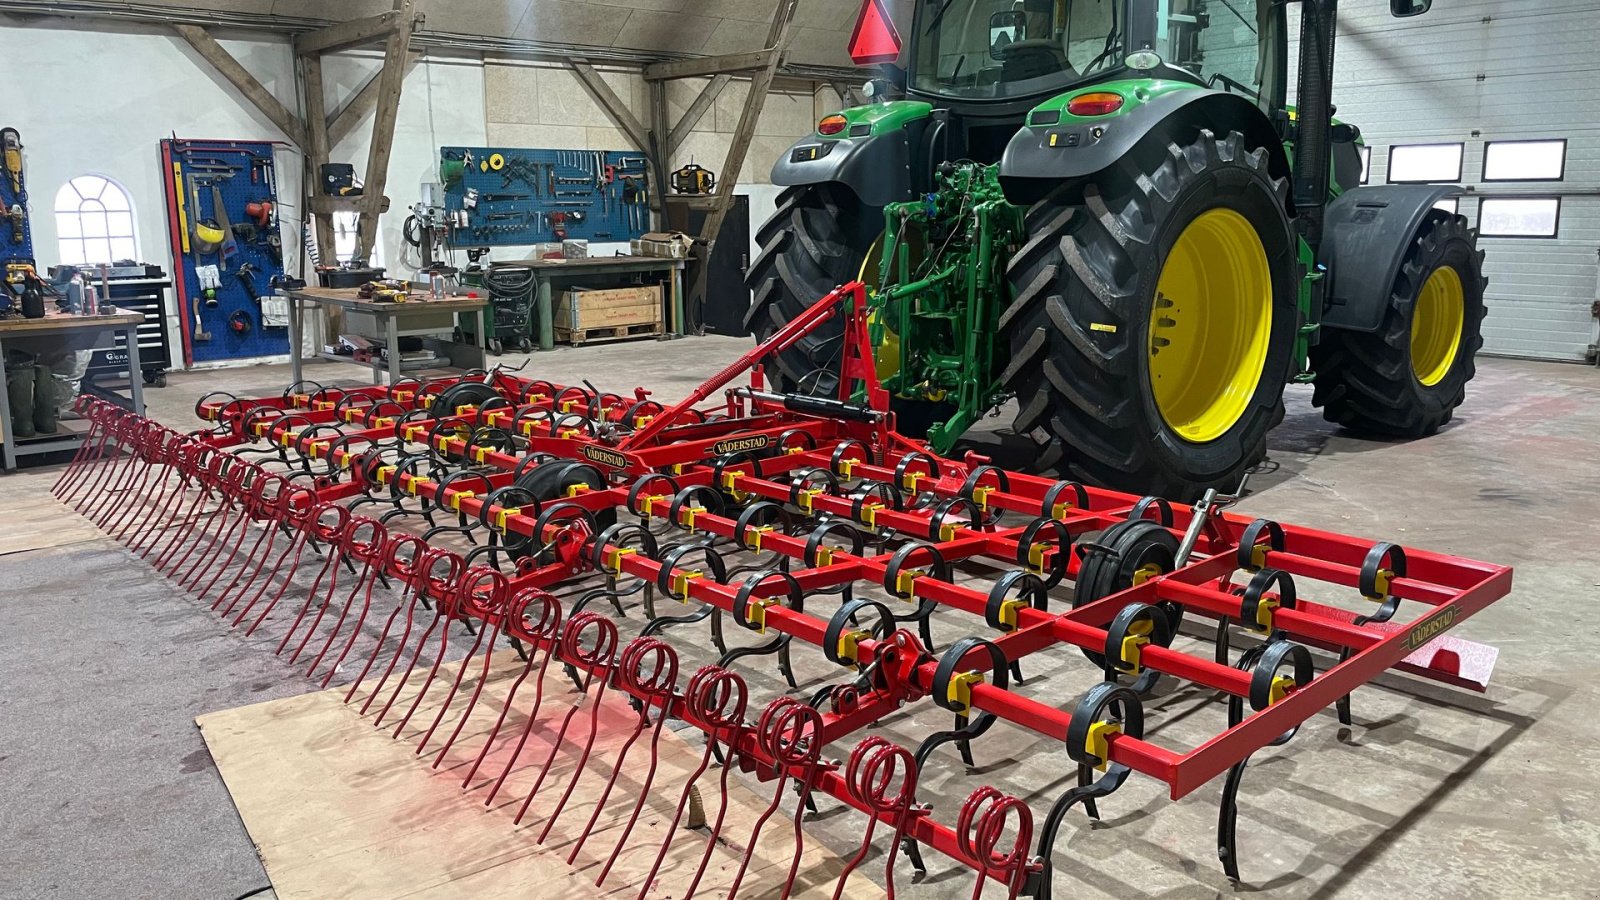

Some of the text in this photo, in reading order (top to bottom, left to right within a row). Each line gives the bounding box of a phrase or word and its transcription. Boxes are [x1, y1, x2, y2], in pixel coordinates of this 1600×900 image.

[717, 437, 766, 453] VÄDERSTAD
[586, 447, 624, 467] VÄDERSTAD
[1412, 610, 1453, 646] VÄDERSTAD
